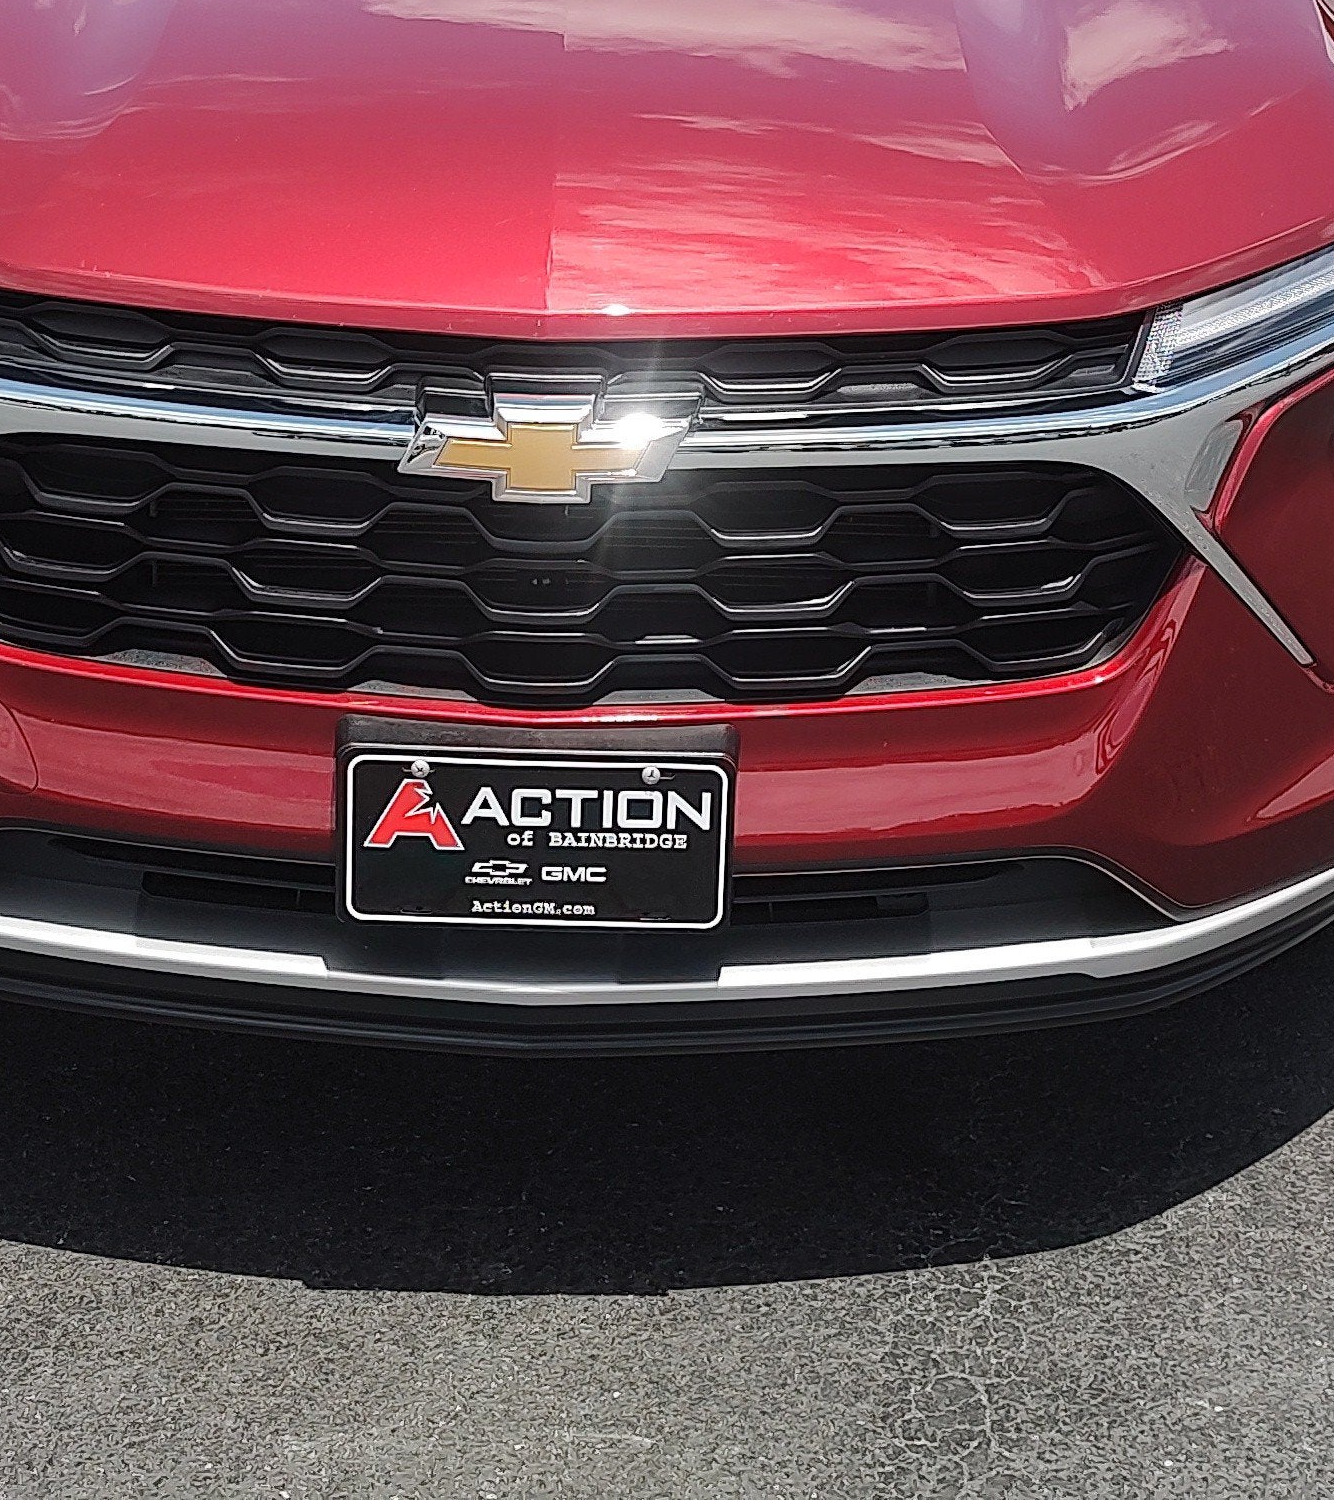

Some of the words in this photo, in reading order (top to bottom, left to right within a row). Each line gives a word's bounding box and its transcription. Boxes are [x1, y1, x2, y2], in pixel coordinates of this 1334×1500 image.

[461, 786, 712, 831] ACTION
[506, 830, 535, 847] of
[548, 831, 688, 850] BAINBRIDGE
[464, 876, 533, 886] CHEVROLET
[541, 866, 608, 883] GMC
[471, 899, 596, 915] ActionGM.com
